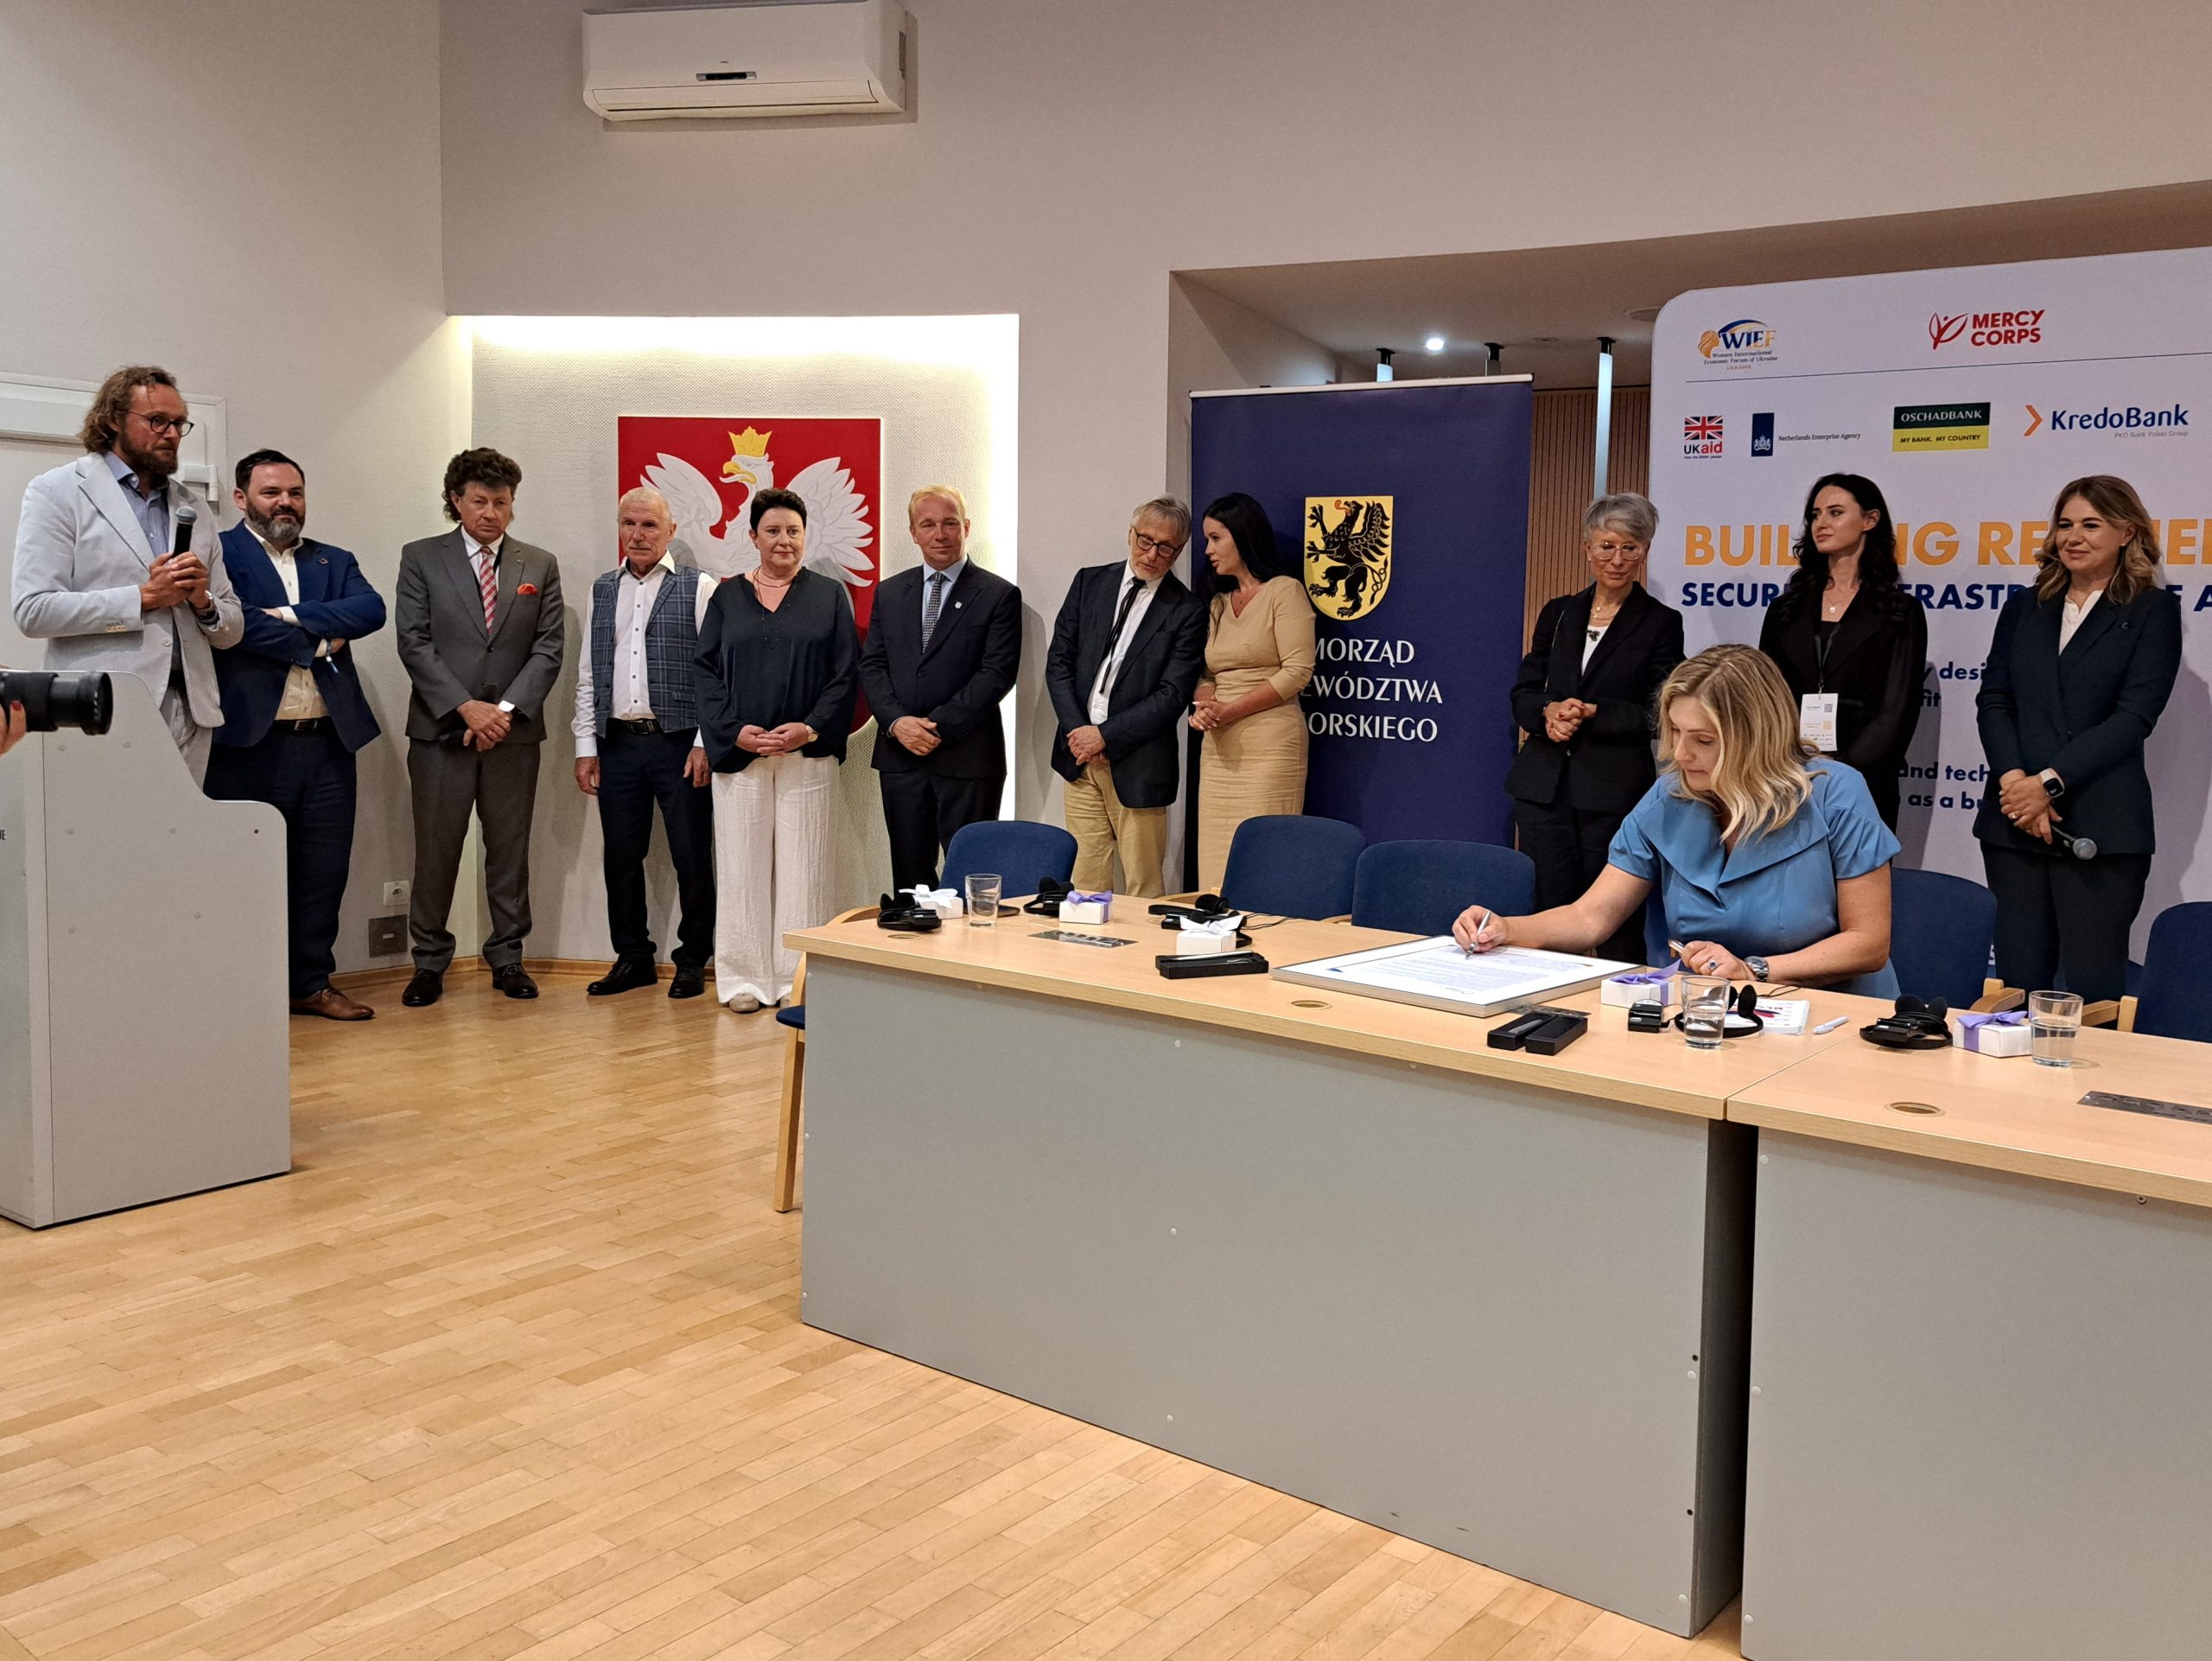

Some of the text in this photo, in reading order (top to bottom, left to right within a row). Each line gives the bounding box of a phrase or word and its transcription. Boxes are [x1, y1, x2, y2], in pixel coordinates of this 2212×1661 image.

[1972, 309, 2045, 329] MERCY
[1721, 330, 1777, 349] WIEF
[1971, 328, 2041, 347] CORPS
[1901, 410, 1983, 422] OSCHADBANK
[2051, 404, 2190, 430] KredoBank
[1681, 582, 1790, 608] SECUR
[1308, 712, 1438, 742] ORSKIEGO
[1908, 794, 1933, 807] as
[1940, 796, 1954, 808] a
